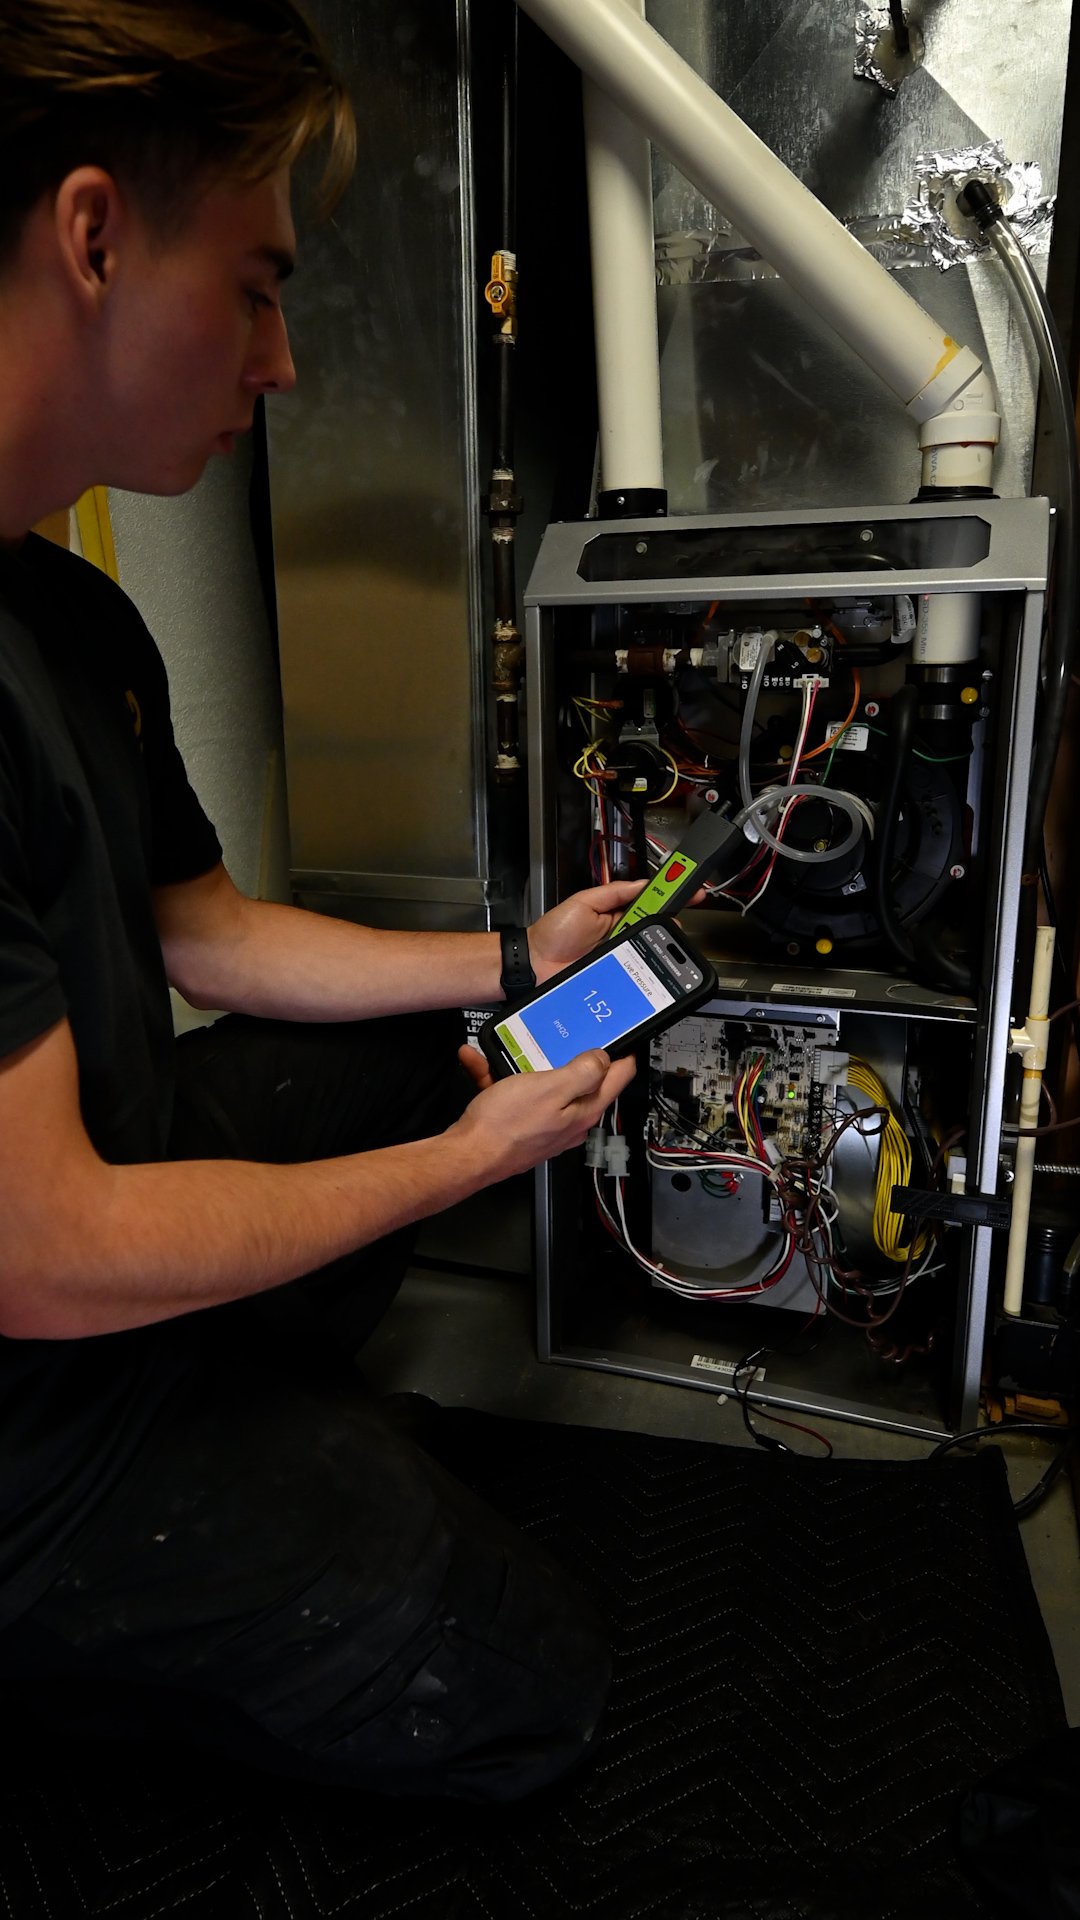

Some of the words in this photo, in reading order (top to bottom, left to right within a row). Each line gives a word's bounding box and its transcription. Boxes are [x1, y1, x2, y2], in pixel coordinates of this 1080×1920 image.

[623, 960, 635, 973] Live
[633, 971, 653, 997] Pressure
[462, 1010, 494, 1020] EORG
[583, 990, 612, 1023] 1.52
